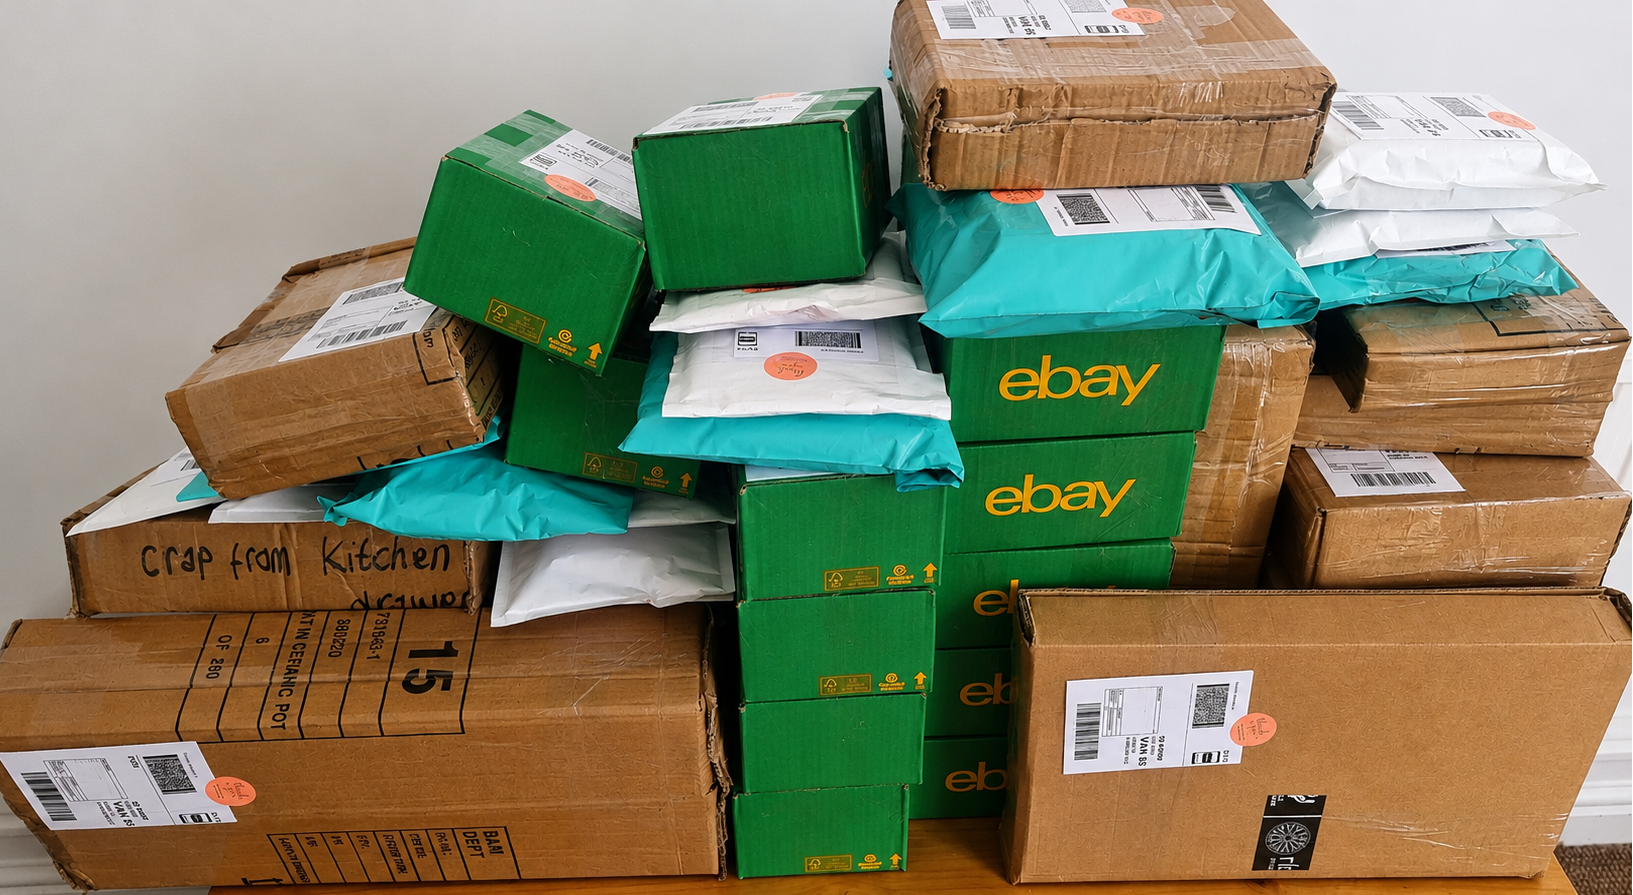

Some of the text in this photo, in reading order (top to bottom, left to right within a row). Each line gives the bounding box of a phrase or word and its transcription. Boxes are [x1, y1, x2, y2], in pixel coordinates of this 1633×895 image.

[998, 355, 1162, 406] ebay
[985, 473, 1137, 518] ebay
[141, 536, 451, 581] Crap from Kitchen
[215, 635, 232, 651] OF
[402, 641, 459, 694] 15
[270, 704, 291, 730] POT
[462, 831, 485, 859] DEPT
